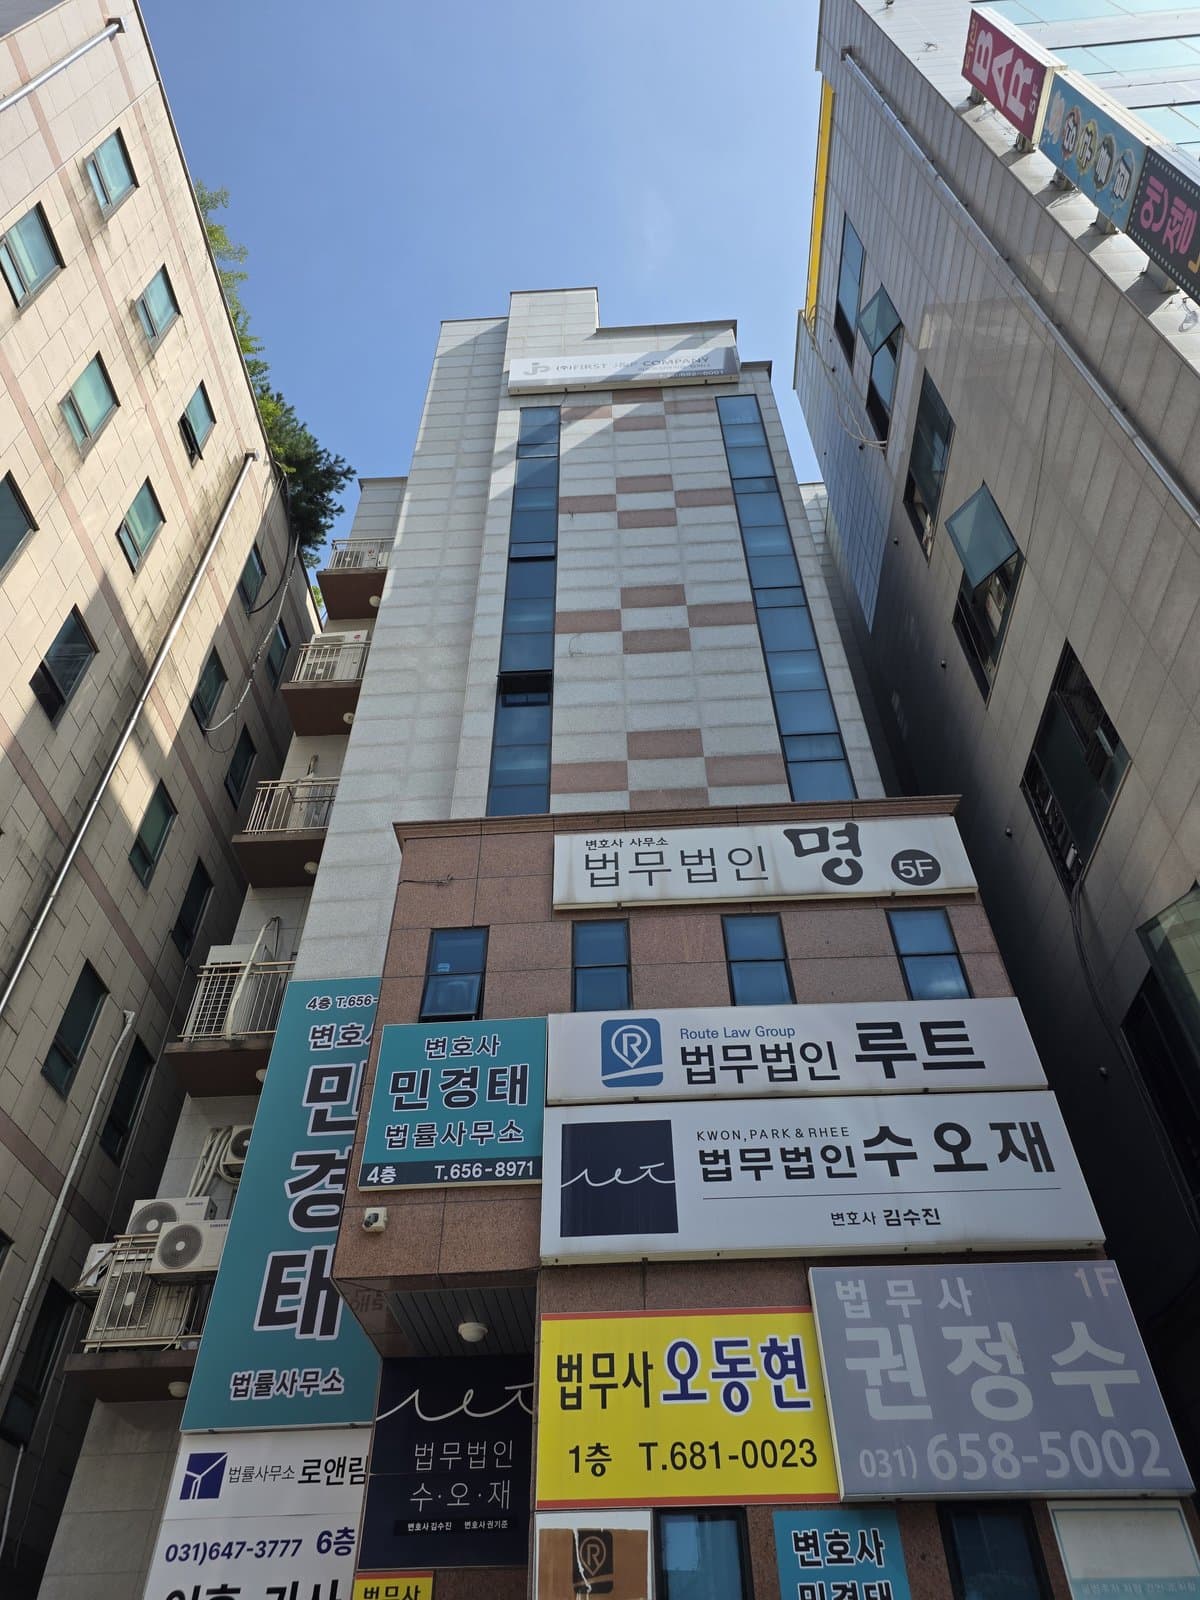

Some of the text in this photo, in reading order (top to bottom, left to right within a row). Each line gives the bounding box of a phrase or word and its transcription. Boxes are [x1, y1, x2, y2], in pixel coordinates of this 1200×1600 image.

[972, 31, 1033, 121] BAR
[1139, 176, 1197, 254] 엔젤
[585, 837, 669, 849] 변호사 사무소
[585, 822, 933, 888] 법무법인 명 5F
[425, 1034, 501, 1061] 변호사
[680, 1025, 796, 1040] Route Law Group
[680, 1020, 985, 1085] 법무법인 루트
[389, 1063, 530, 1112] 민경태
[385, 1120, 525, 1150] 법률사무소
[698, 1144, 858, 1182] 법무법인
[862, 1121, 1055, 1177] 수오재
[807, 1126, 850, 1139] RHEE
[367, 1161, 533, 1184] 4층 T.656-8971
[830, 1208, 942, 1227] 변호사 김수진
[835, 1266, 1120, 1319] 법무사 1F
[230, 1368, 345, 1400] 법률사무소
[556, 1351, 654, 1411] 법무사
[660, 1334, 813, 1415] 오동현
[845, 1321, 1141, 1421] 권정수
[228, 1464, 295, 1484] 법률사무소
[414, 1439, 514, 1473] 법무법인
[568, 1438, 818, 1478] 1층 T.681-0023
[858, 1428, 1172, 1481] 031) 658-5002
[407, 1521, 452, 1531] 변호사 김수진
[464, 1520, 485, 1529] 변호사
[164, 1527, 356, 1566] 031)647-3777 6층
[792, 1528, 885, 1568] 변호사
